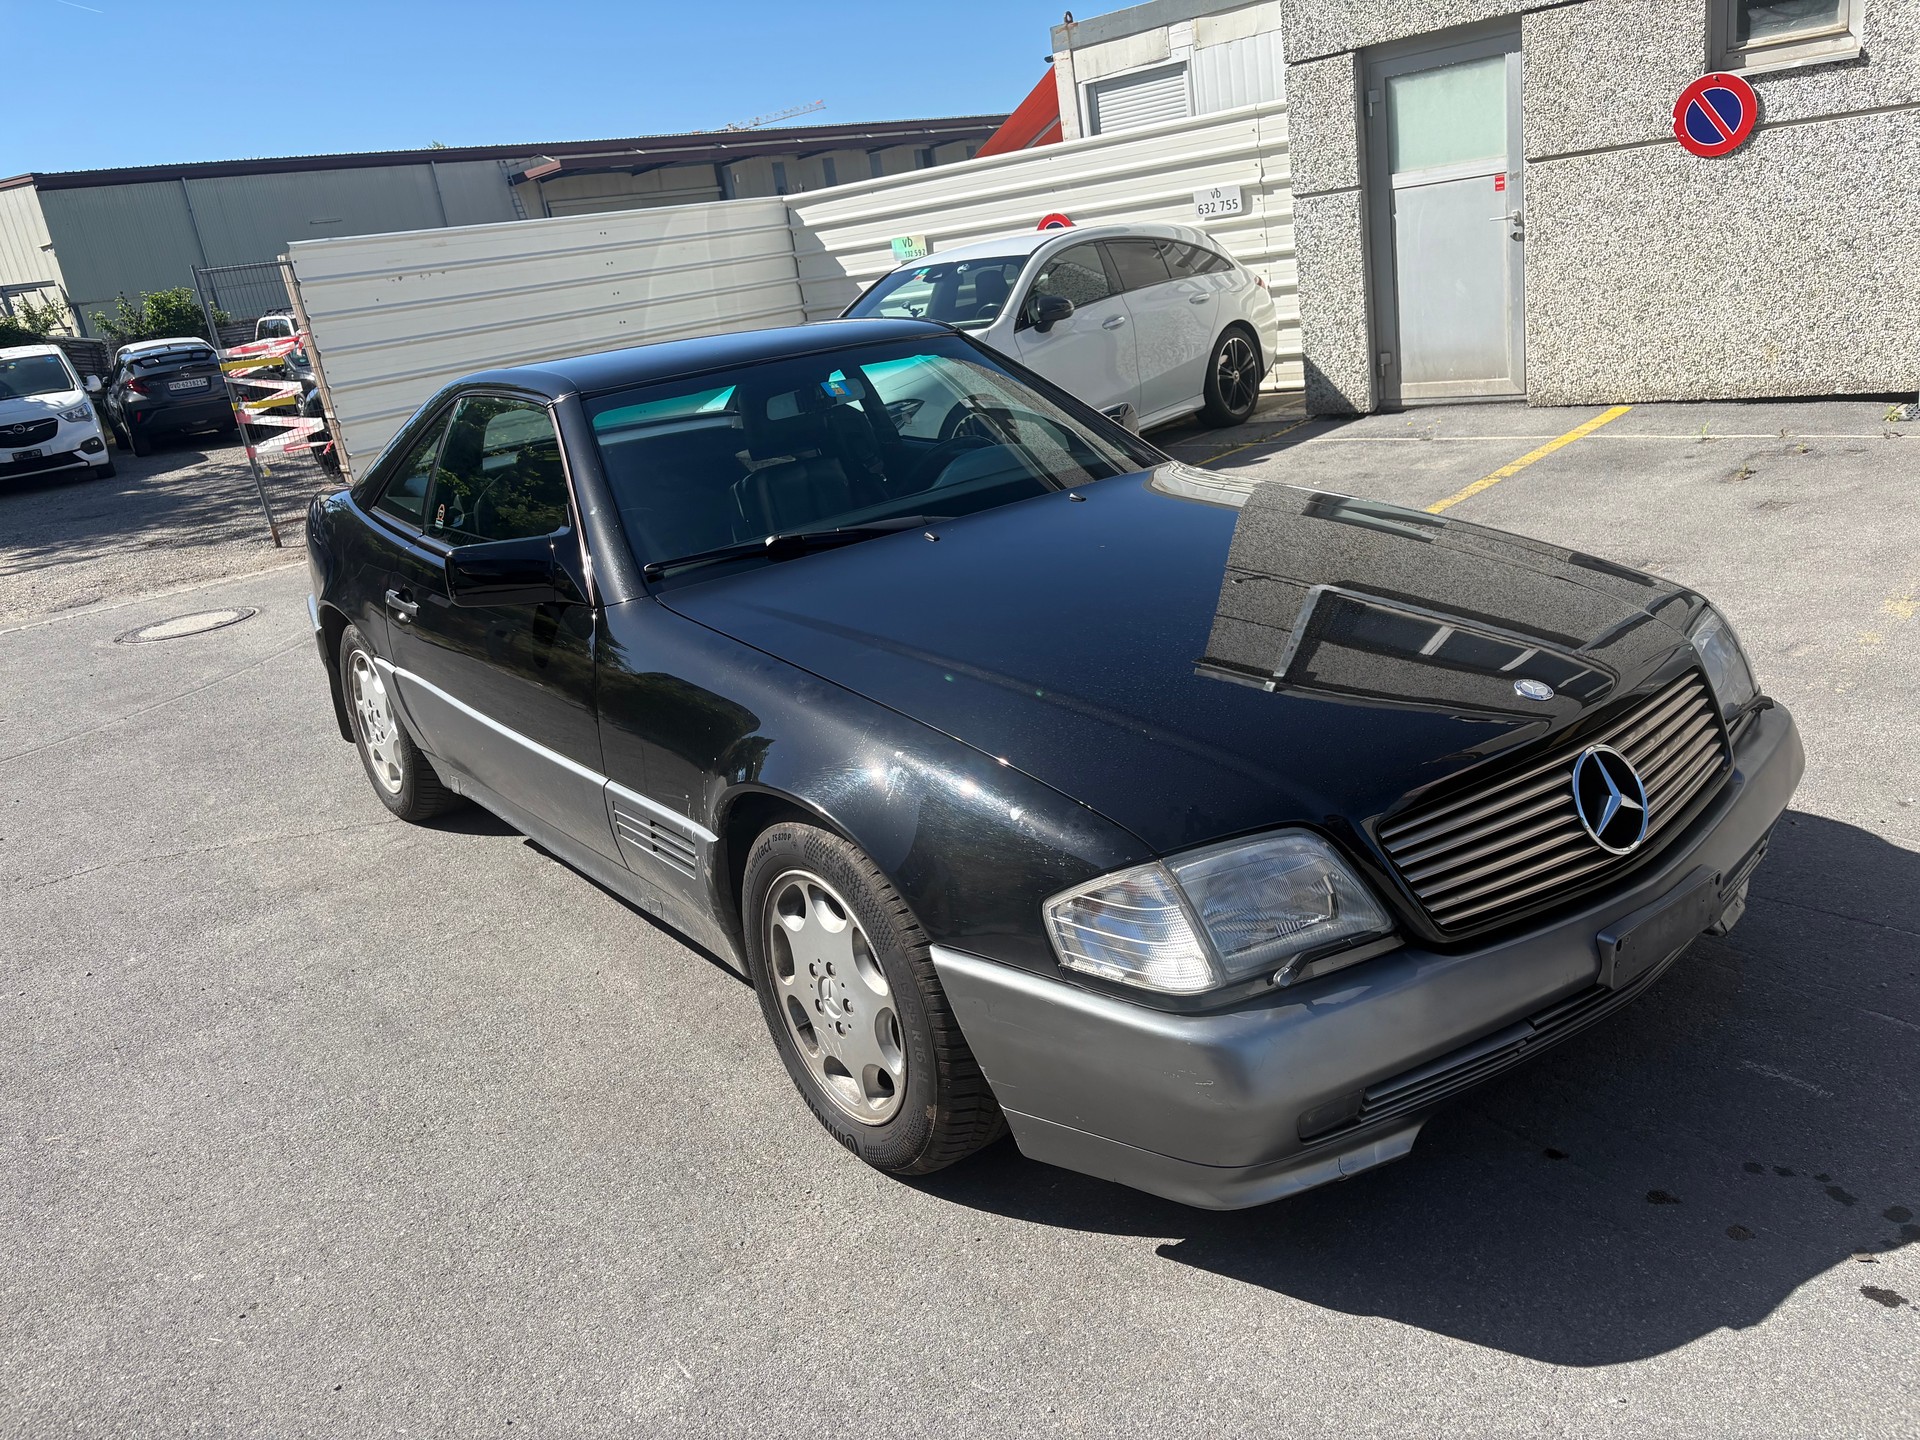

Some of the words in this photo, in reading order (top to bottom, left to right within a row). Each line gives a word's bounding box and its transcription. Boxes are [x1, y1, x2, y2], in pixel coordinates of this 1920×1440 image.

[1197, 202, 1217, 215] 632
[1219, 198, 1239, 212] 755
[904, 250, 914, 258] 132
[914, 248, 926, 257] 592
